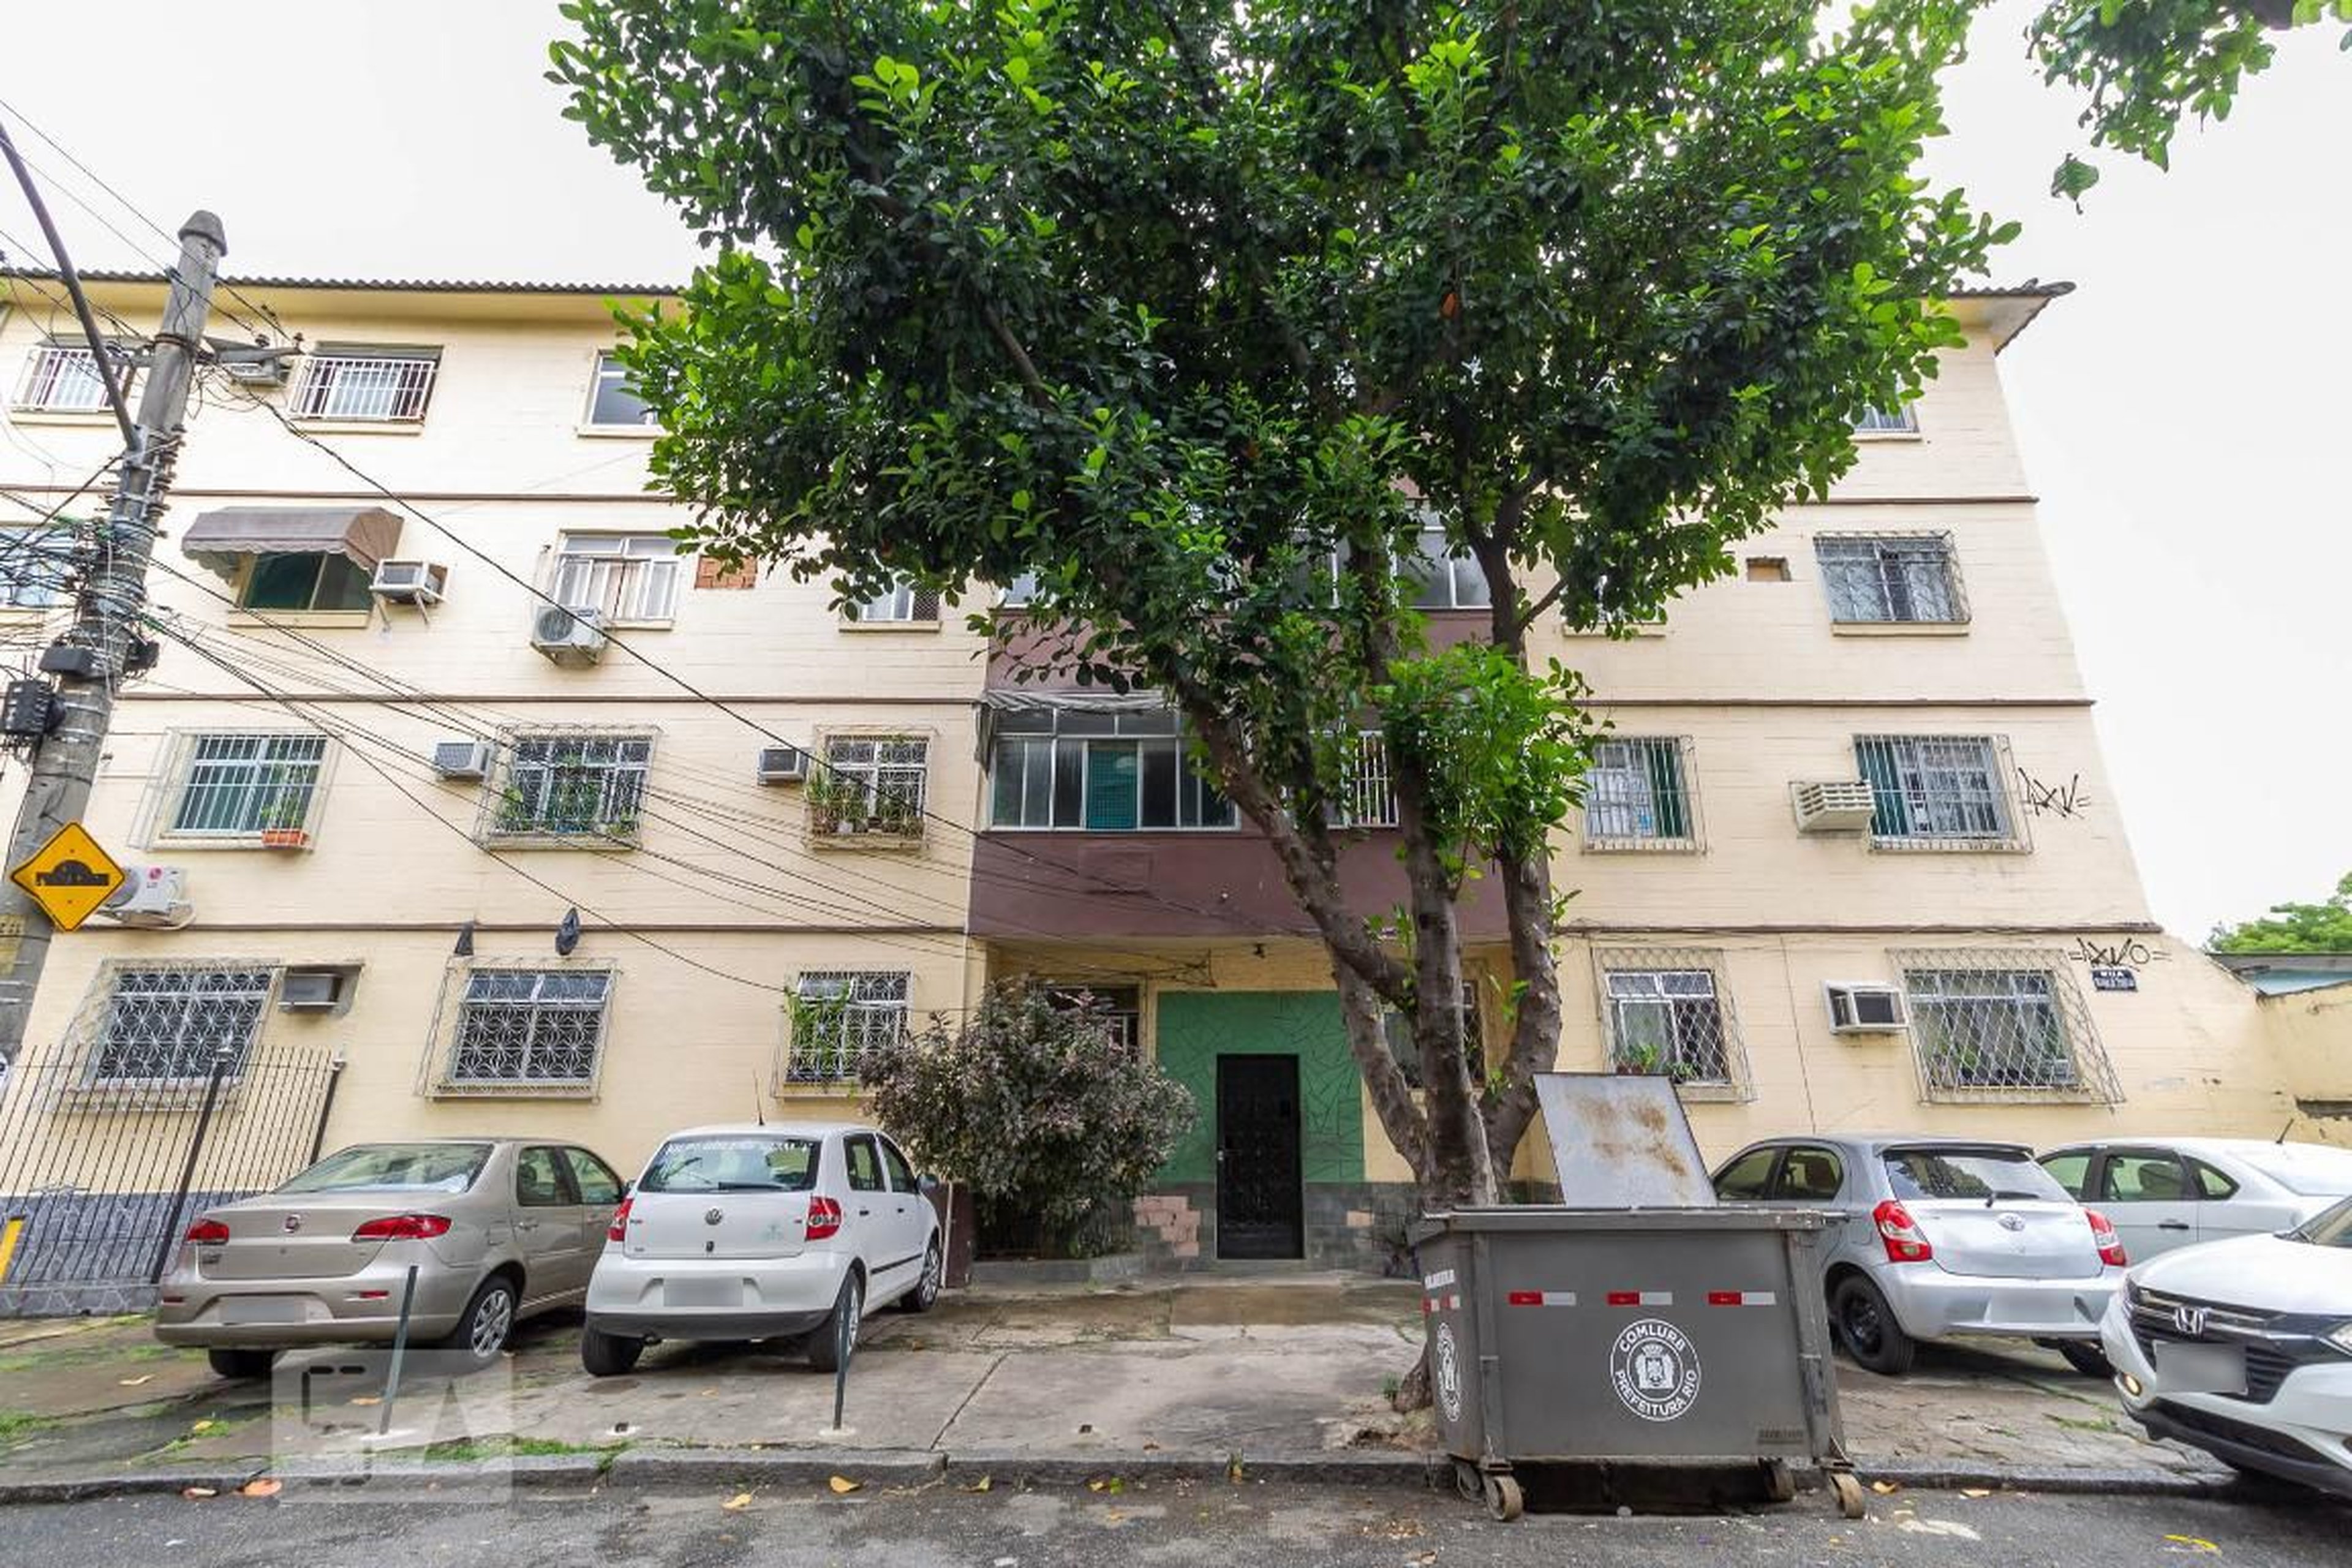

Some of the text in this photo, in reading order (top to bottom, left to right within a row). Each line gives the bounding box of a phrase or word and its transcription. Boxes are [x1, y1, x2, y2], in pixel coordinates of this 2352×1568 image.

[1618, 1324, 1686, 1352] COMLURB
[1615, 1368, 1697, 1417] PREFEITURA RIO
